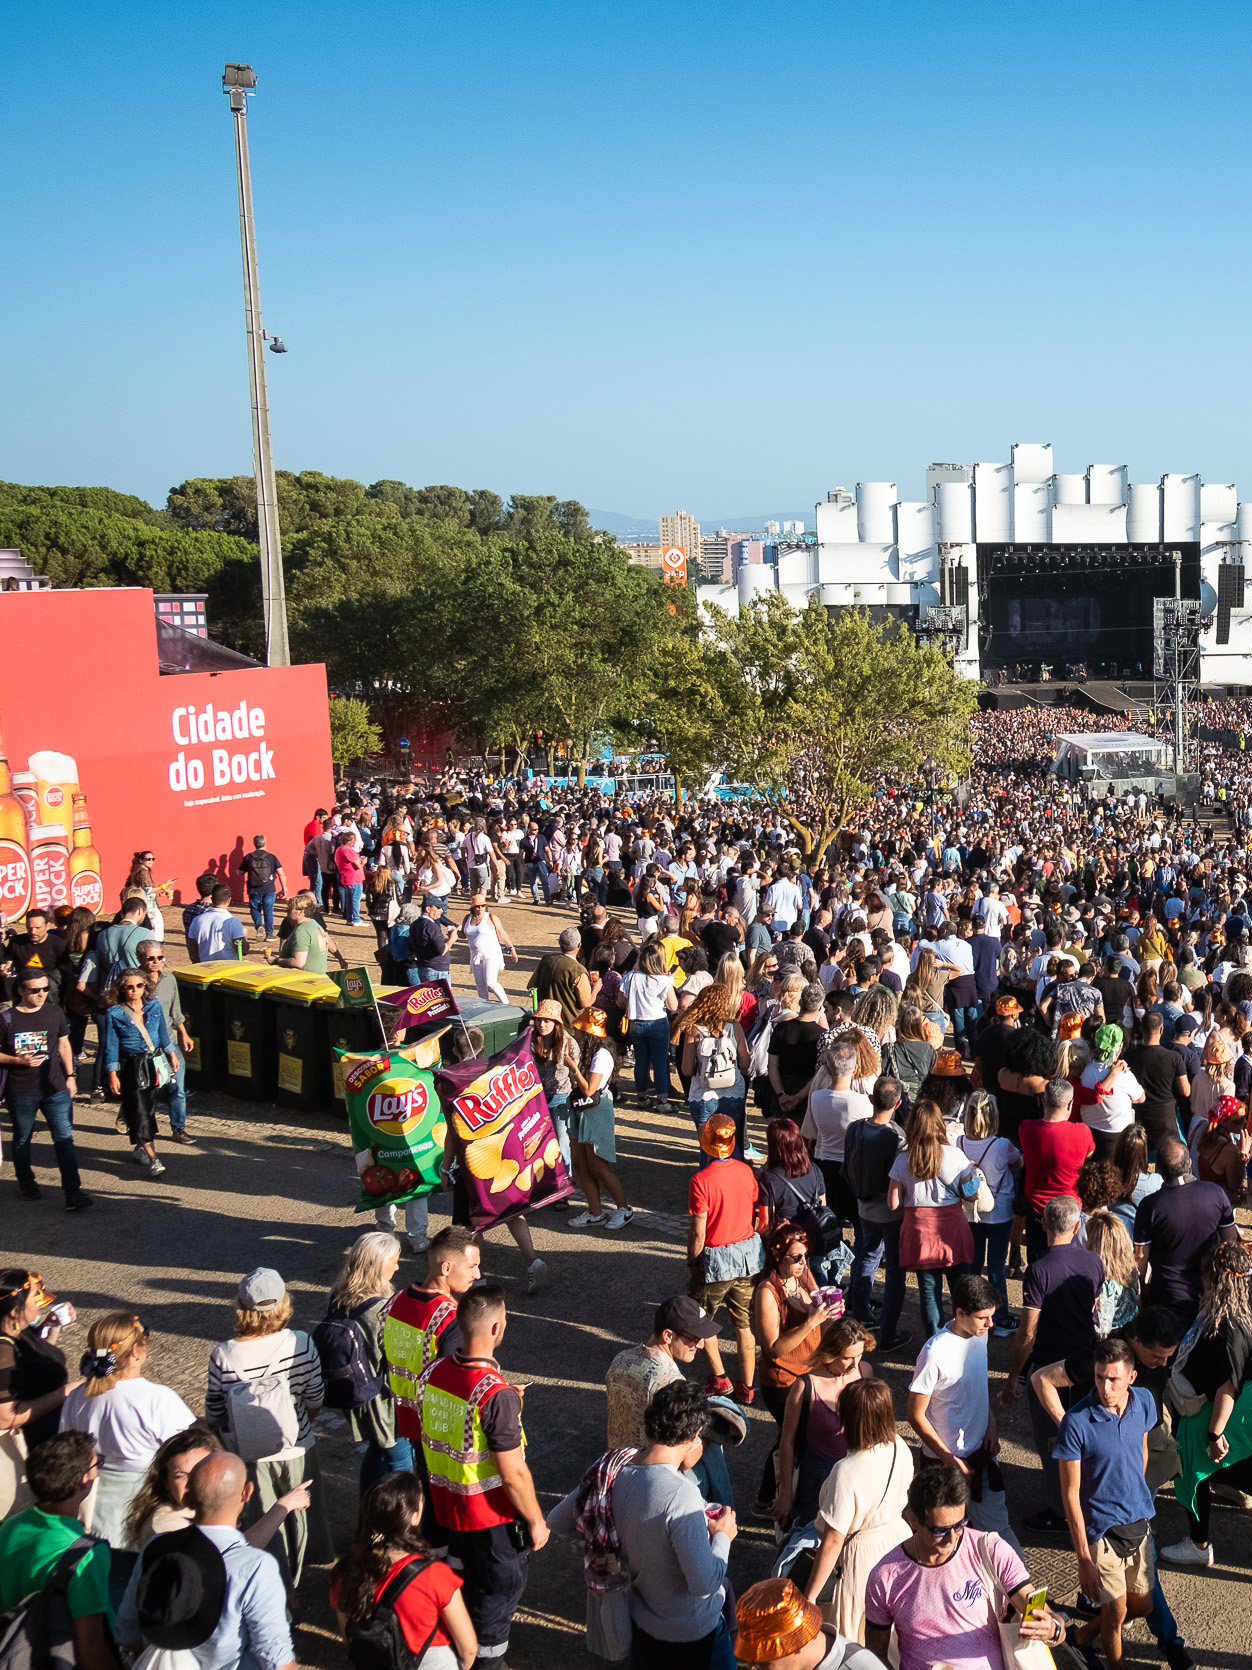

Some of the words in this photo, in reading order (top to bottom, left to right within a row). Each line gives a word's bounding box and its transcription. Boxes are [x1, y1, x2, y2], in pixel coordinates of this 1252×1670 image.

[172, 700, 266, 745] Cidade
[169, 751, 205, 792] do
[212, 741, 276, 786] Bock
[33, 856, 51, 911] UPER
[73, 882, 101, 897] SUPER
[75, 892, 100, 906] BOCK
[346, 979, 363, 992] Lay's
[408, 987, 445, 1010] Ruffles
[354, 1063, 384, 1088] SABOR
[373, 1086, 424, 1122] Lay's
[453, 1061, 535, 1131] Ruffles
[572, 1096, 594, 1108] FILA
[378, 1140, 434, 1158] Camponesas
